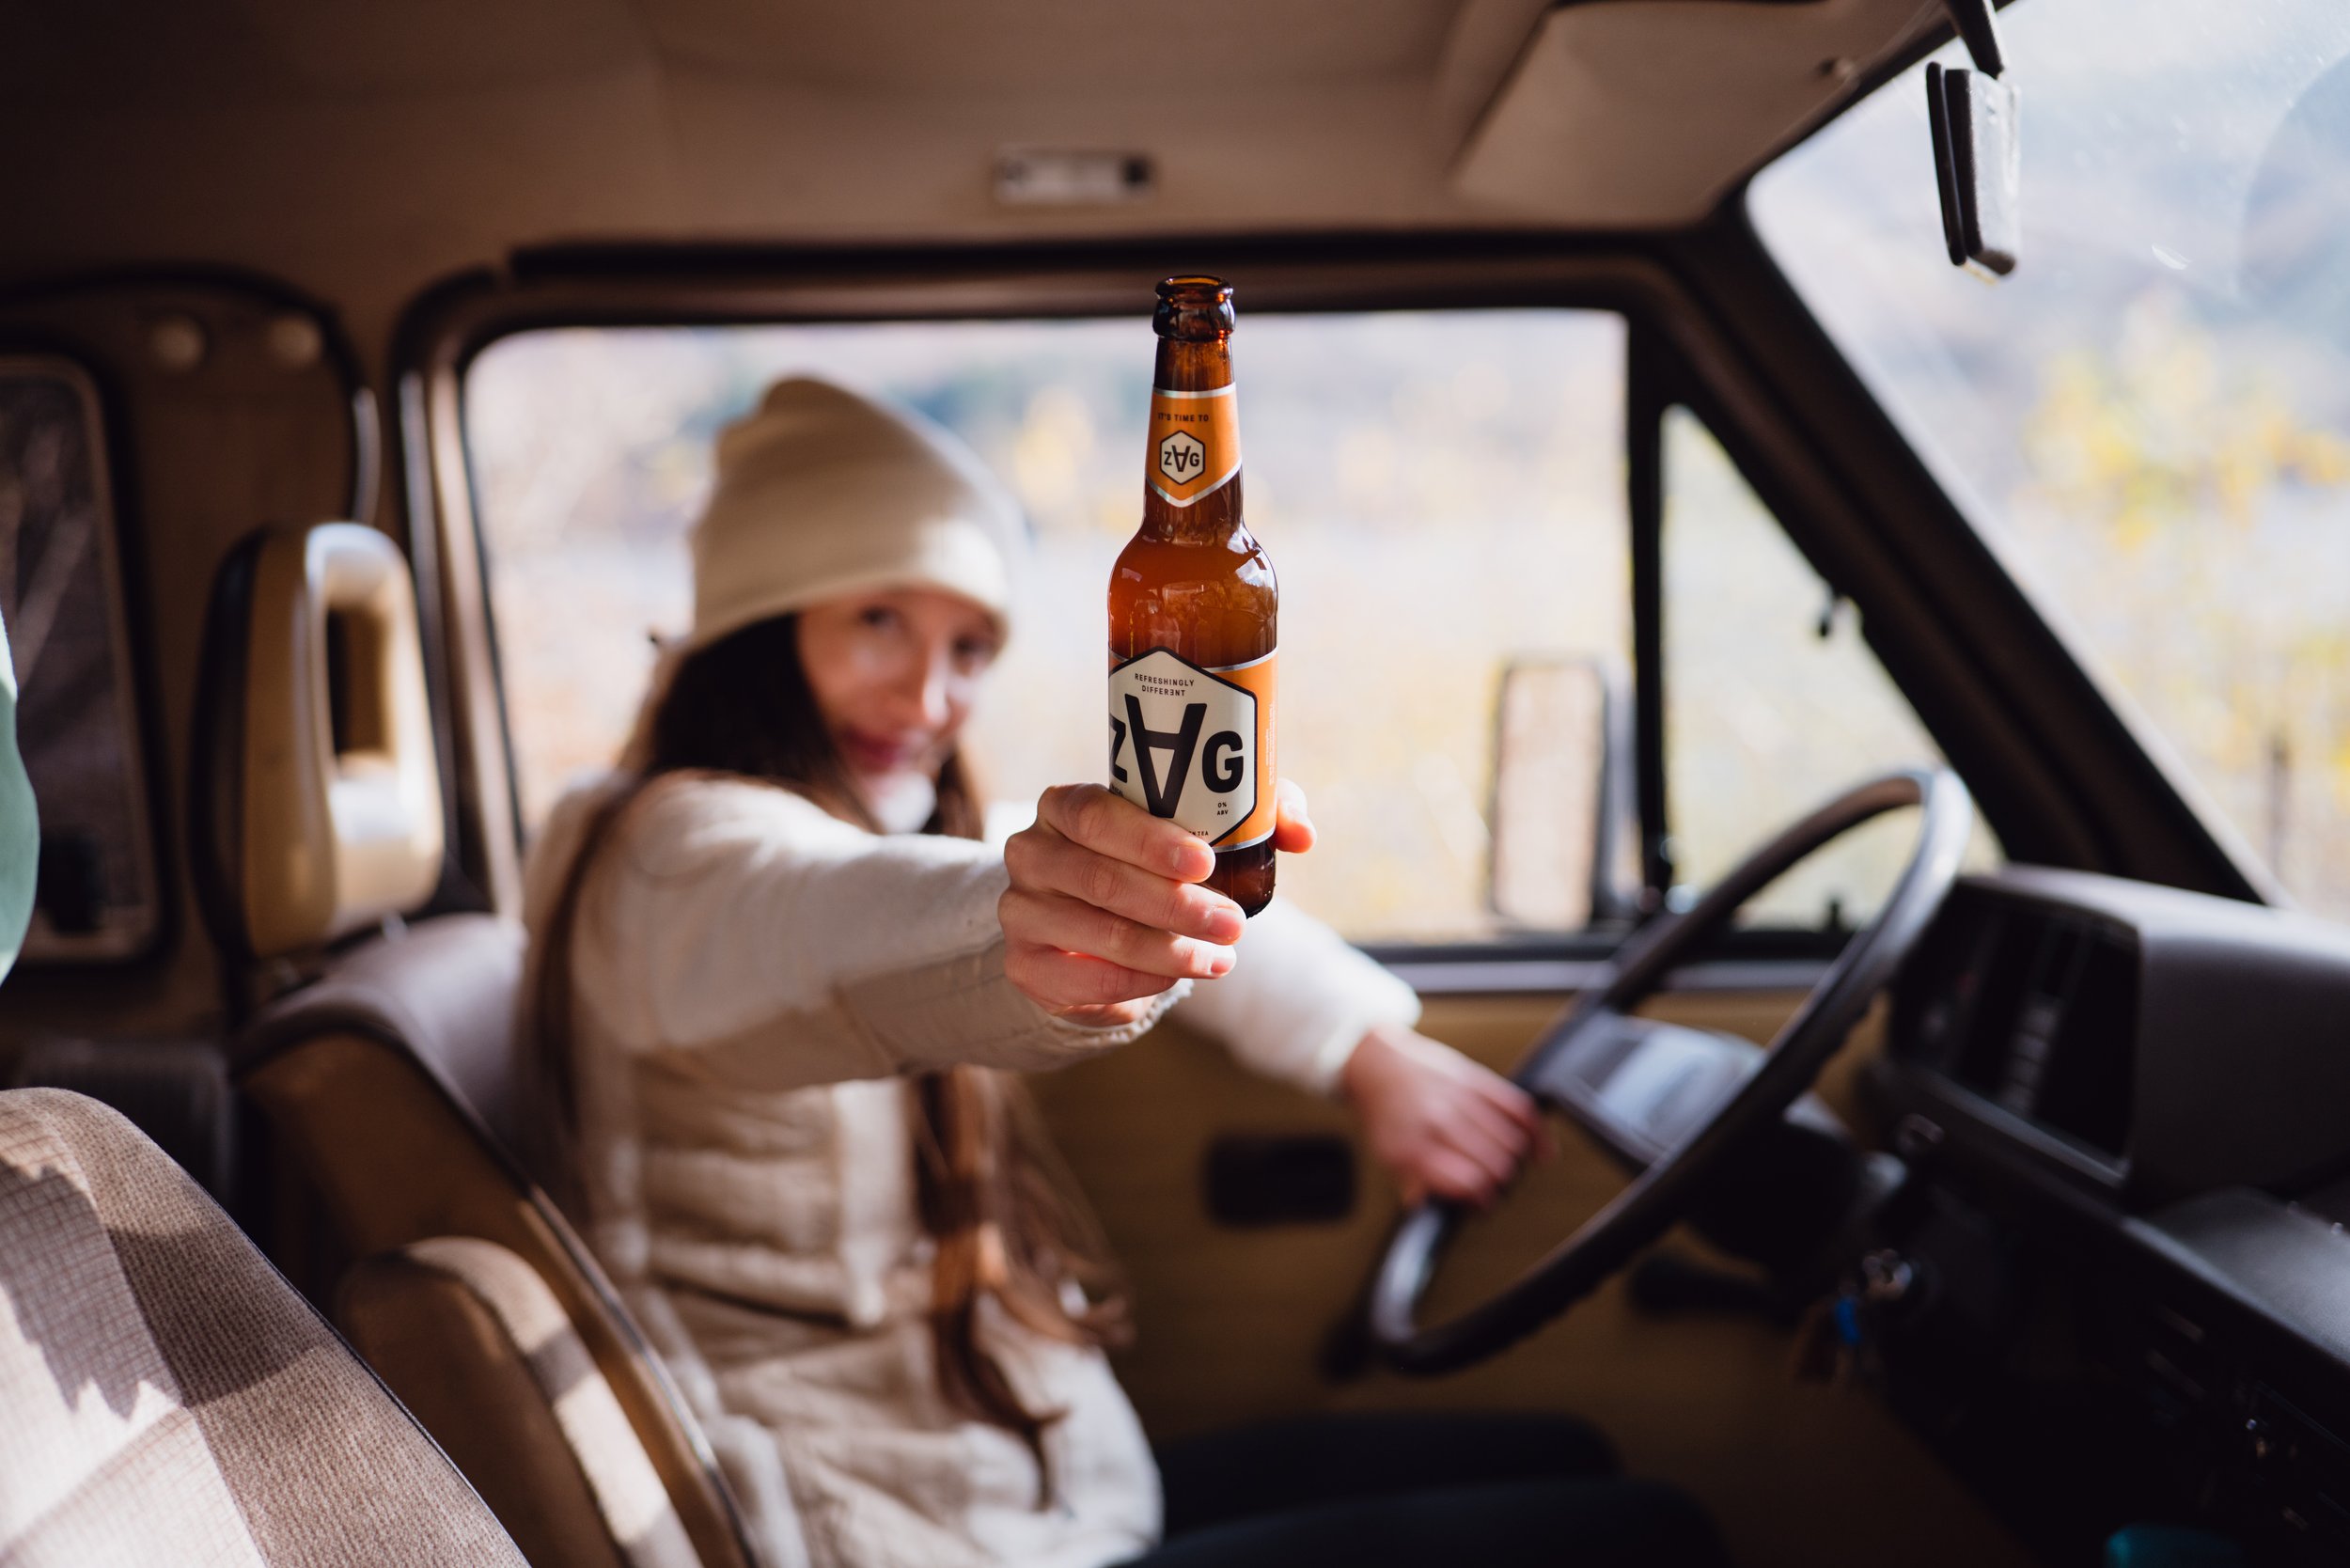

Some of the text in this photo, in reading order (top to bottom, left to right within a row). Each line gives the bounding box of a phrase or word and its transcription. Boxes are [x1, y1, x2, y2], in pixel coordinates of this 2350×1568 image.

[1158, 413, 1171, 421] IT'S
[1174, 414, 1195, 422] TIME
[1135, 673, 1195, 686] REFRESHINGLY
